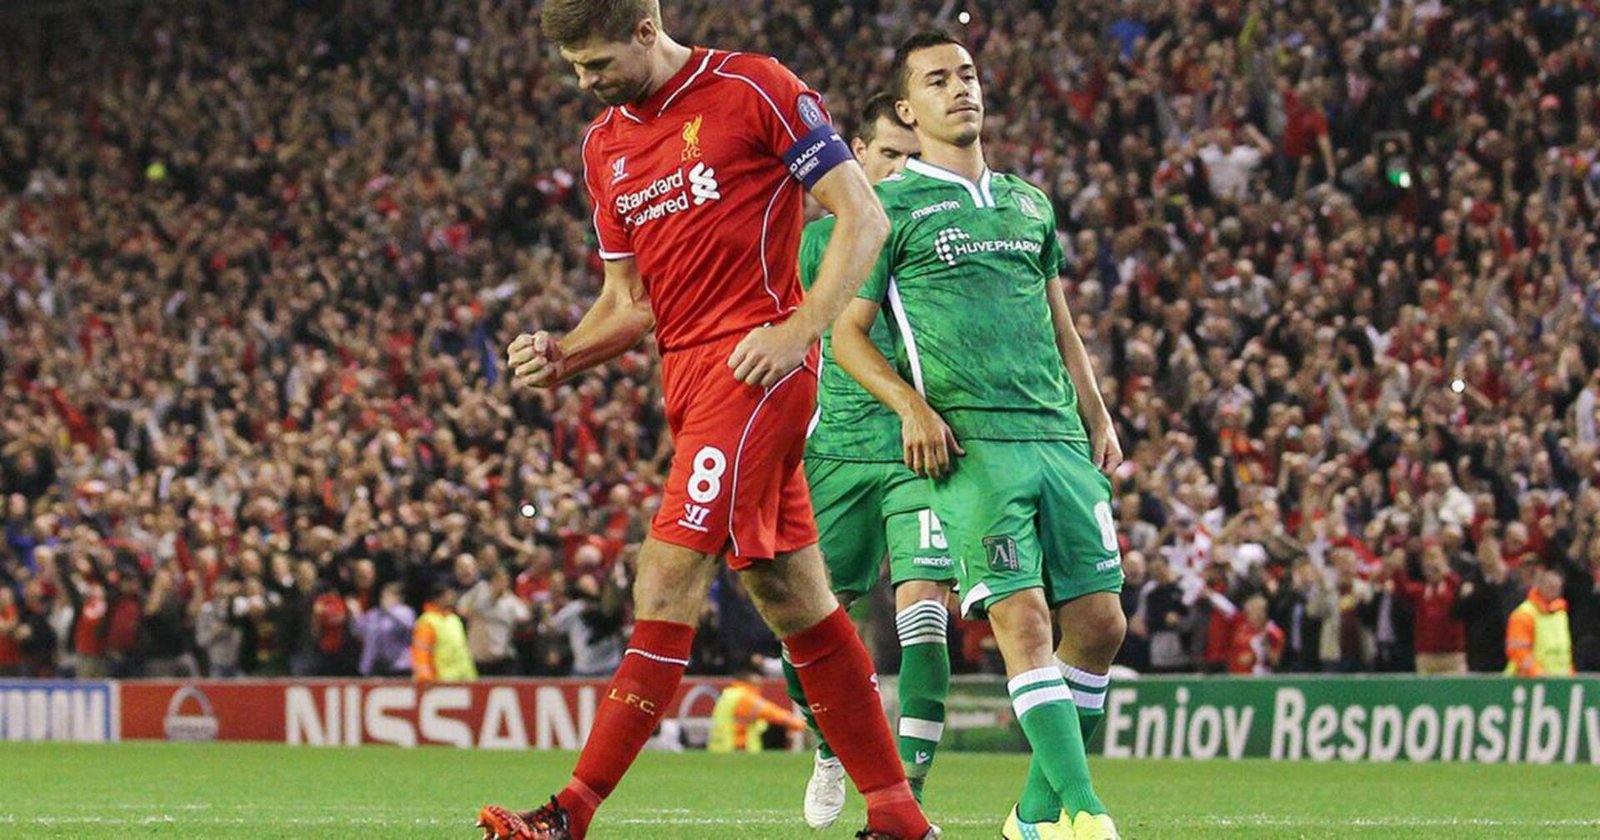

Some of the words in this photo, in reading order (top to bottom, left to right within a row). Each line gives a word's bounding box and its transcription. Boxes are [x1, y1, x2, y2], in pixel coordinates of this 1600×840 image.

[615, 167, 684, 215] Standard
[623, 190, 690, 229] artered
[687, 446, 727, 503] 8
[285, 686, 597, 750] NISSAN
